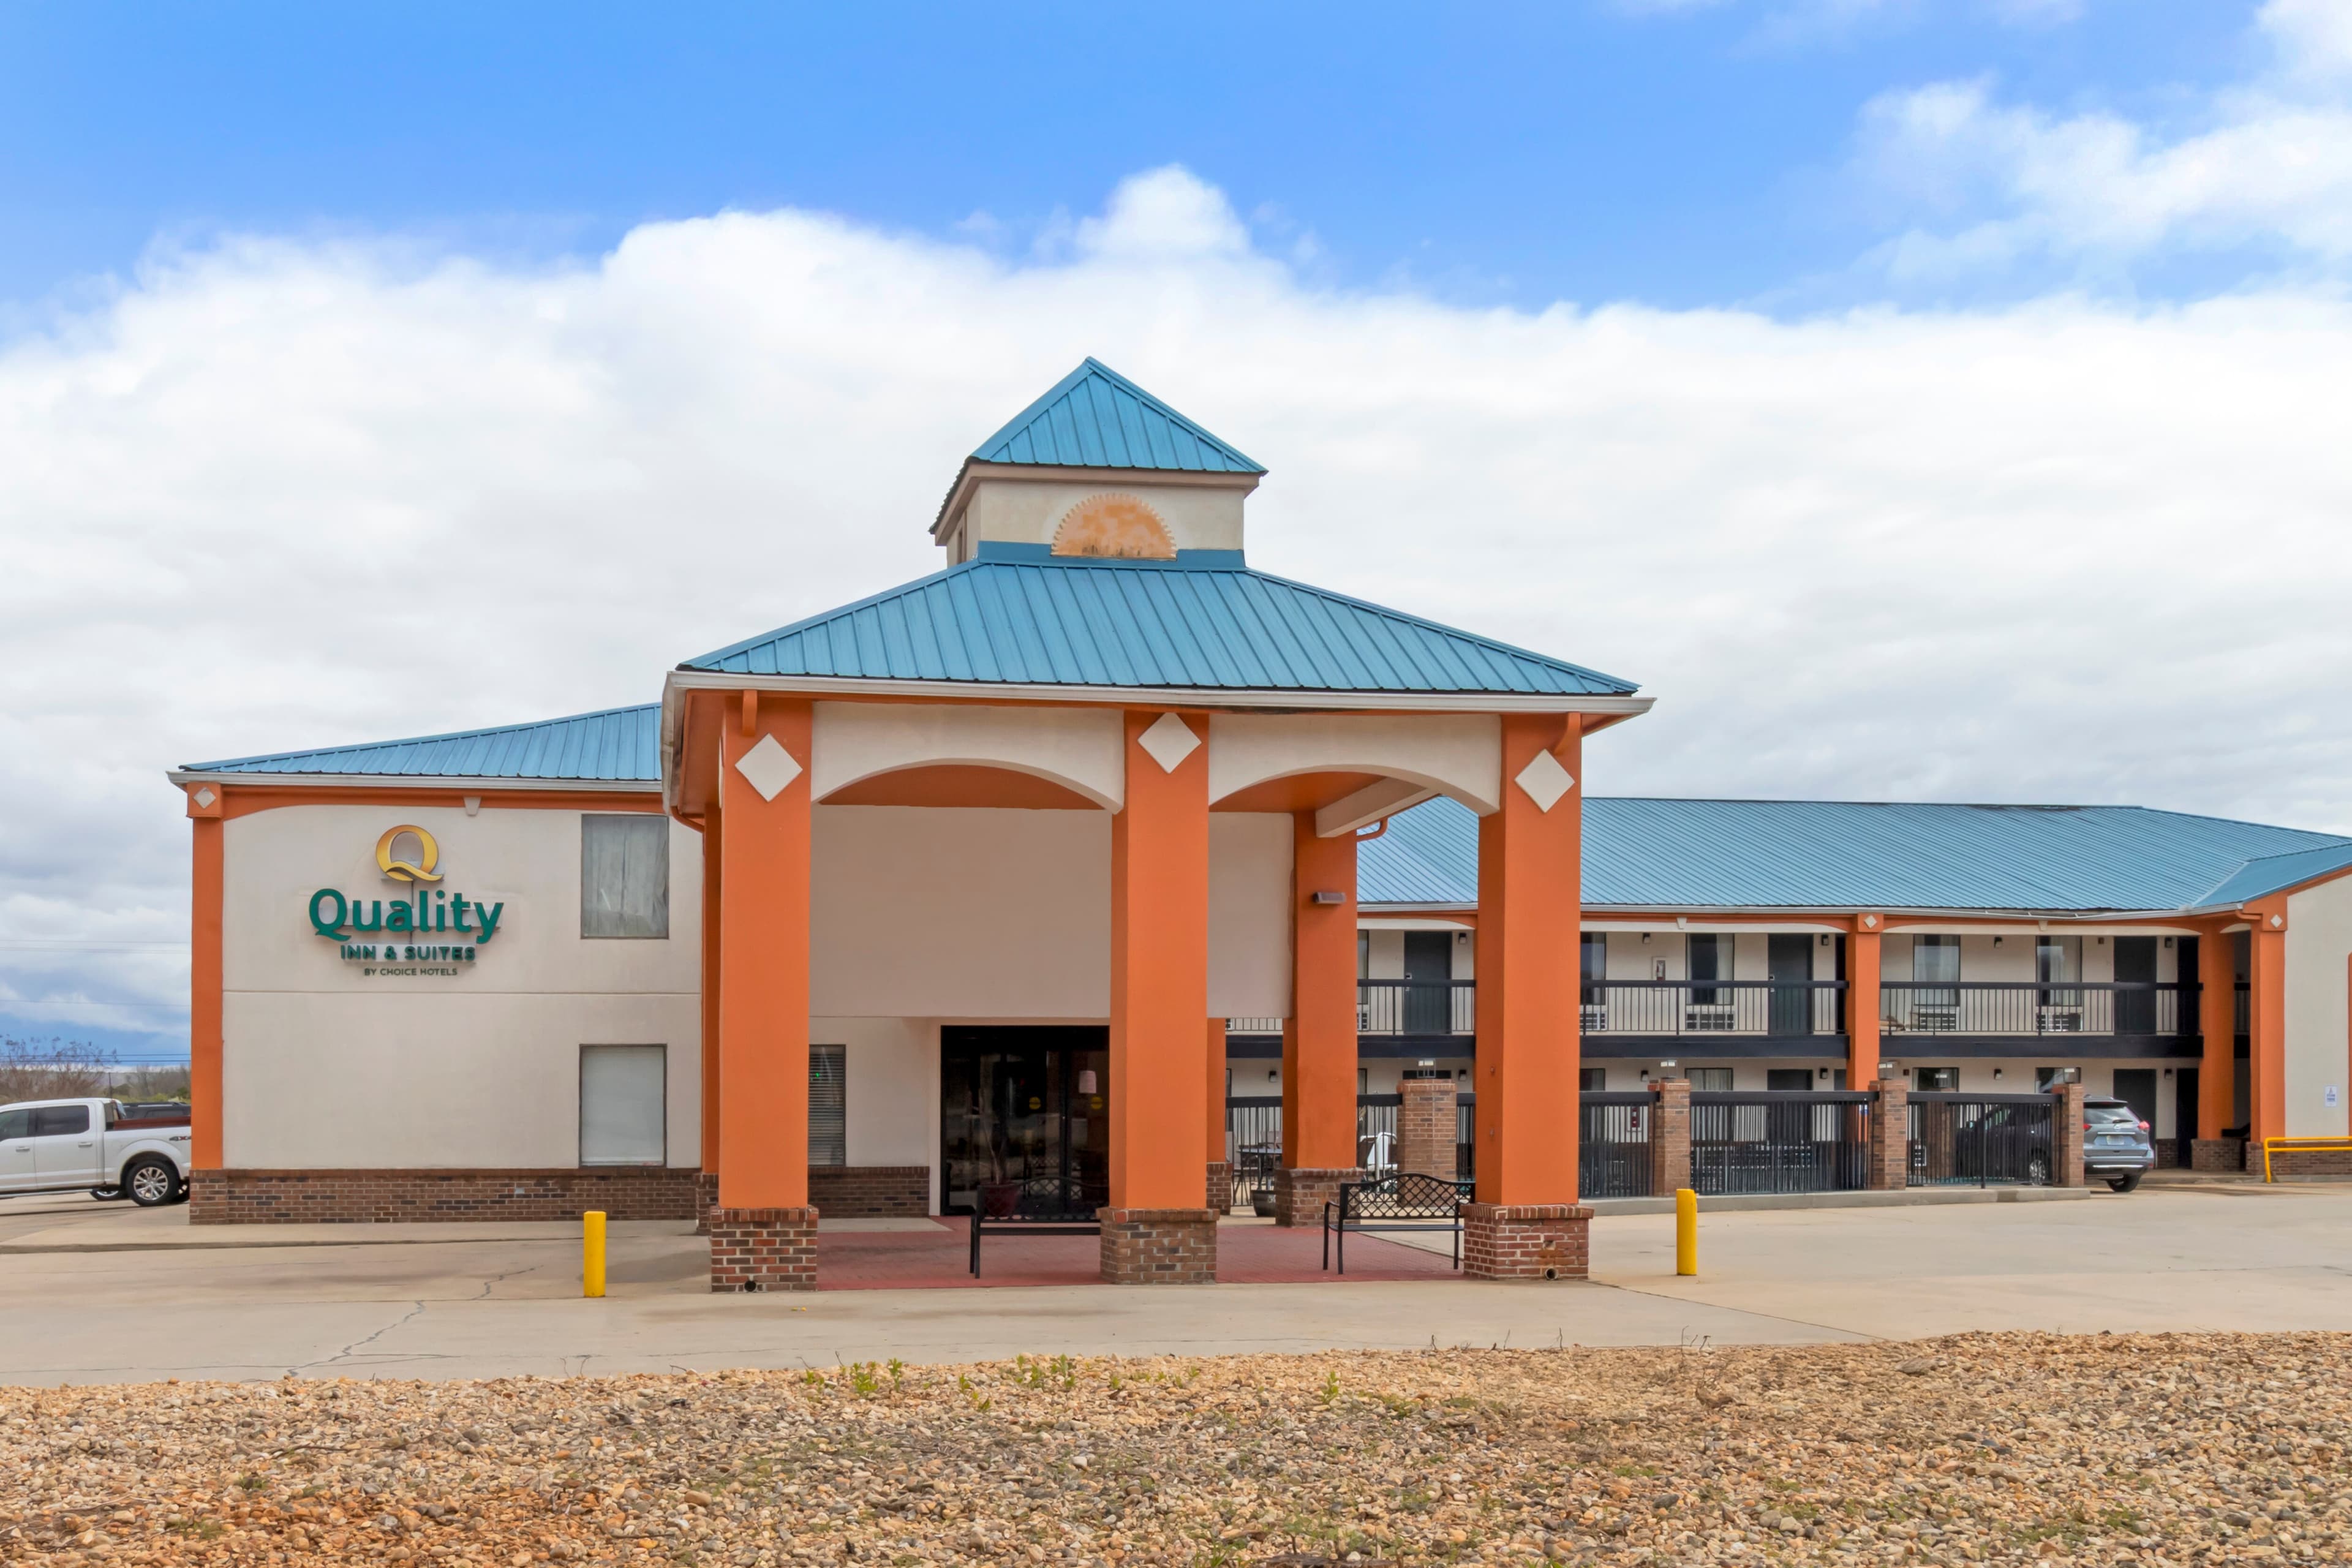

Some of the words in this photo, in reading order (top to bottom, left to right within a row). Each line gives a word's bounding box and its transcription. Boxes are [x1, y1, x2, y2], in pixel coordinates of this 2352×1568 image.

[375, 824, 444, 882] Q
[309, 888, 504, 944] Quality
[340, 944, 376, 960] INN
[384, 945, 397, 960] &
[404, 946, 476, 961] SUITES
[364, 968, 377, 976] BY
[380, 968, 417, 976] CHOICE
[420, 968, 458, 976] HOTELS
